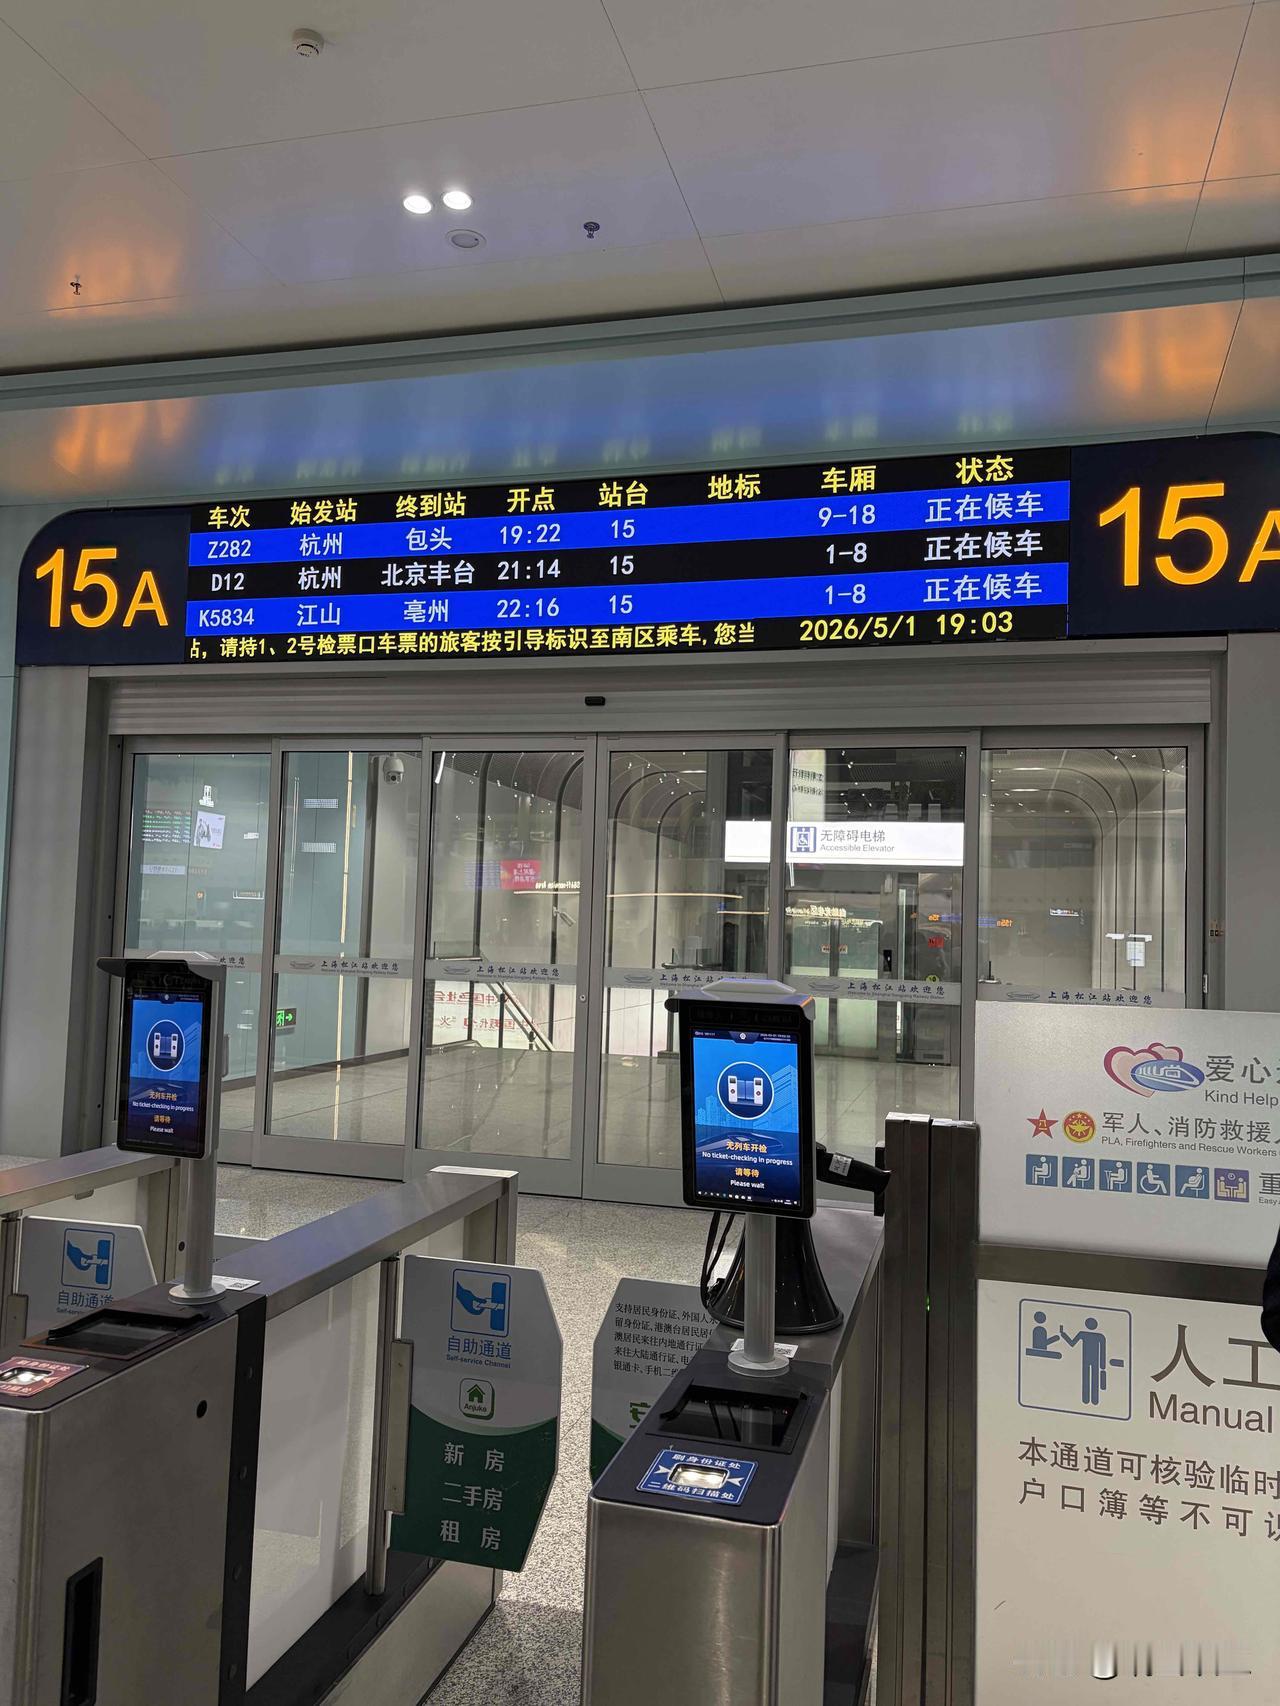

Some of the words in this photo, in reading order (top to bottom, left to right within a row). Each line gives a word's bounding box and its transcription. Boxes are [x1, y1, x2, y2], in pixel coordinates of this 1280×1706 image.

[208, 506, 250, 528] 车次
[291, 499, 357, 525] 始发站
[396, 493, 466, 518] 终到站
[507, 488, 556, 513] 开点
[599, 481, 649, 507] 站台
[708, 475, 761, 499] 地标
[821, 466, 876, 491] 车厢
[956, 456, 1014, 483] 状态
[207, 538, 252, 560] Z282
[300, 533, 343, 557] 杭州
[406, 528, 453, 552] 包头
[499, 523, 561, 545] 19:22
[611, 520, 636, 540] 15
[818, 505, 876, 528] 9-18
[925, 491, 1044, 524] 正在候车
[211, 571, 245, 593] D12
[298, 565, 342, 590] 杭州
[381, 560, 475, 588] 北京丰台
[497, 559, 561, 582] 21:14
[609, 555, 635, 576] 15
[826, 543, 868, 564] 1-8
[924, 530, 1043, 562] 正在候车
[199, 606, 255, 628] K5834
[297, 602, 341, 626] 江山
[403, 598, 449, 623] 亳州
[496, 597, 560, 619] 22:16
[608, 595, 633, 614] 15
[825, 585, 867, 605] 1-8
[923, 571, 1043, 604] 正在候车
[799, 615, 917, 643] 2026/5/1
[936, 610, 1014, 636] 19:03
[820, 829, 886, 843] 无障碍电梯
[820, 844, 861, 852] Accessible
[862, 845, 895, 853] Elevator
[320, 960, 400, 972] 上海松江站欢迎您
[476, 965, 560, 977] 上海松江站欢迎您
[848, 982, 945, 995] 上海松江站欢迎您
[1048, 991, 1153, 1005] 上海松江站欢迎您
[1205, 1055, 1280, 1084] 爱心
[1204, 1089, 1239, 1104] Kind
[1243, 1091, 1279, 1109] Help
[153, 1115, 171, 1125] 请等待
[150, 1126, 164, 1134] Please
[726, 1141, 767, 1153] 无列车开检
[1101, 1136, 1123, 1147] PLA,
[1125, 1138, 1177, 1150] Firefighters
[1178, 1141, 1196, 1151] and
[1198, 1143, 1234, 1154] Rescue
[1236, 1145, 1277, 1157] Workers
[712, 1152, 758, 1164] ticket-checking
[765, 1157, 793, 1166] progress
[735, 1168, 760, 1178] 请等待
[730, 1179, 750, 1188] Please
[751, 1181, 765, 1189] wait
[615, 1317, 713, 1339] 留身份证、港澳台居民居
[447, 1336, 512, 1360] 自助通道
[1151, 1323, 1280, 1392] 人工
[446, 1354, 483, 1366] Self-service
[484, 1359, 511, 1369] Channel
[1149, 1391, 1273, 1434] Manual
[671, 1453, 741, 1470] 刷身份证处
[1018, 1436, 1280, 1500] 本通道可核验临时
[442, 1481, 503, 1511] 二手房
[647, 1481, 735, 1500] 二维码扫描处
